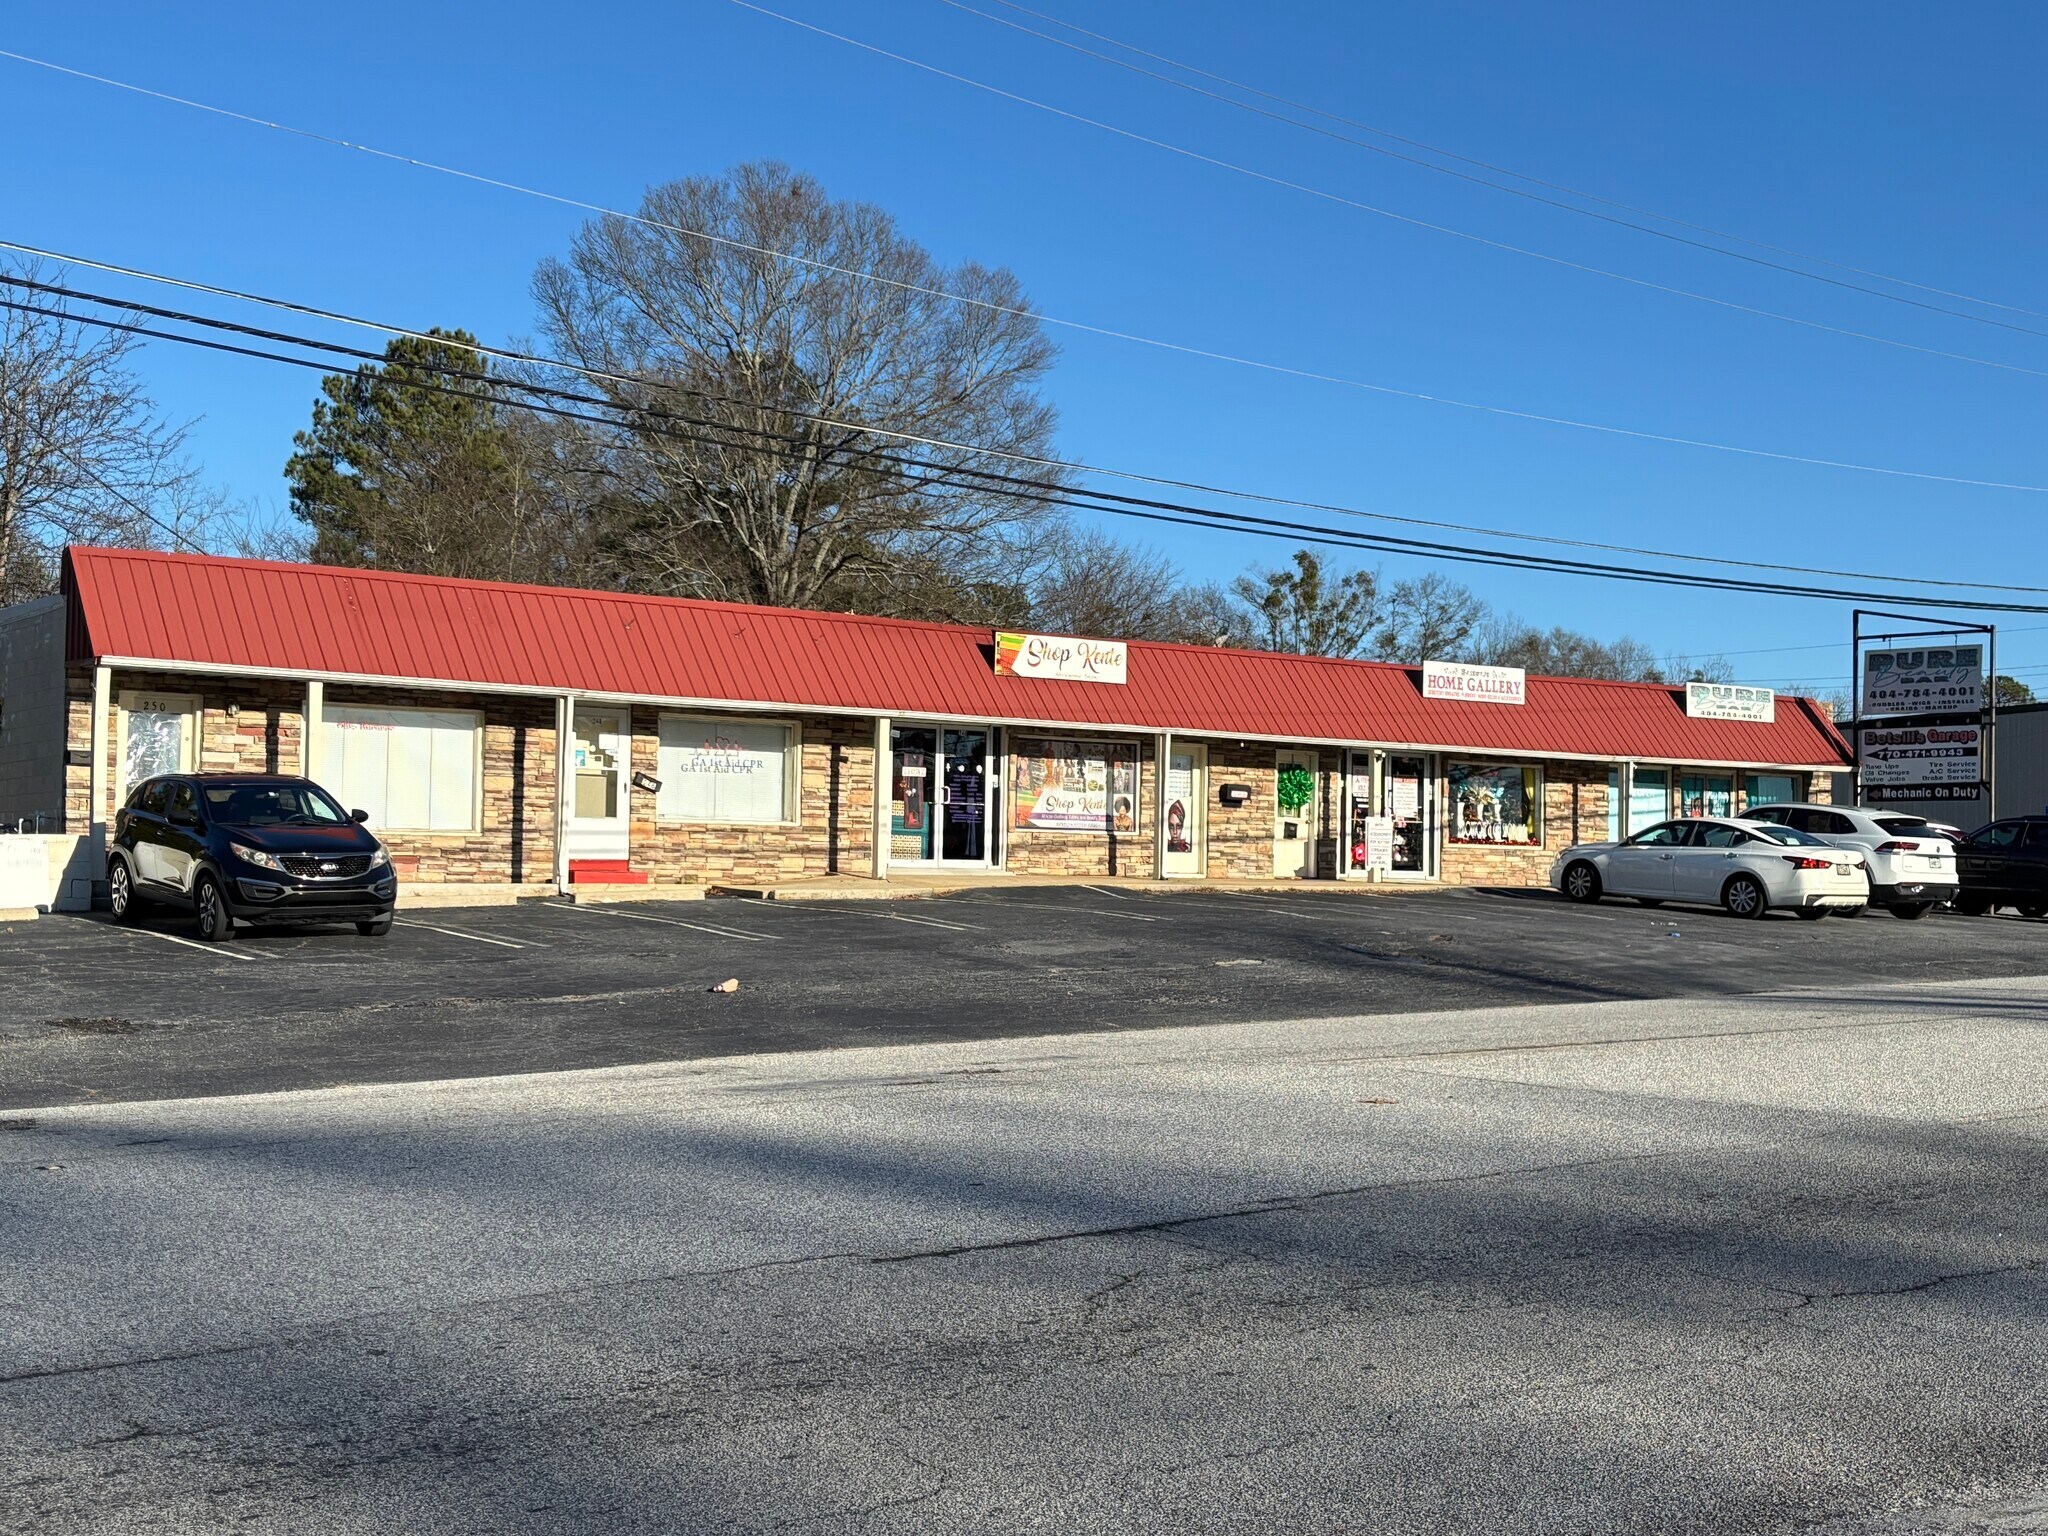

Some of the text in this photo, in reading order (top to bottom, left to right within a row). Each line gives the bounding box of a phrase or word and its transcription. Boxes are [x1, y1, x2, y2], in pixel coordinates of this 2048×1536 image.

[1027, 638, 1123, 674] Shop Kente
[1868, 648, 1979, 672] PURE
[1427, 674, 1522, 695] HOME GALLERY
[1869, 686, 1975, 699] 404-784-4001
[1690, 685, 1771, 703] PURE
[143, 701, 166, 712] 250
[1864, 729, 1978, 746] Betsill's Garage
[1877, 748, 1964, 759] 770-471-9943
[1882, 787, 1978, 799] Mechanic On Duty
[1046, 796, 1075, 812] Shop
